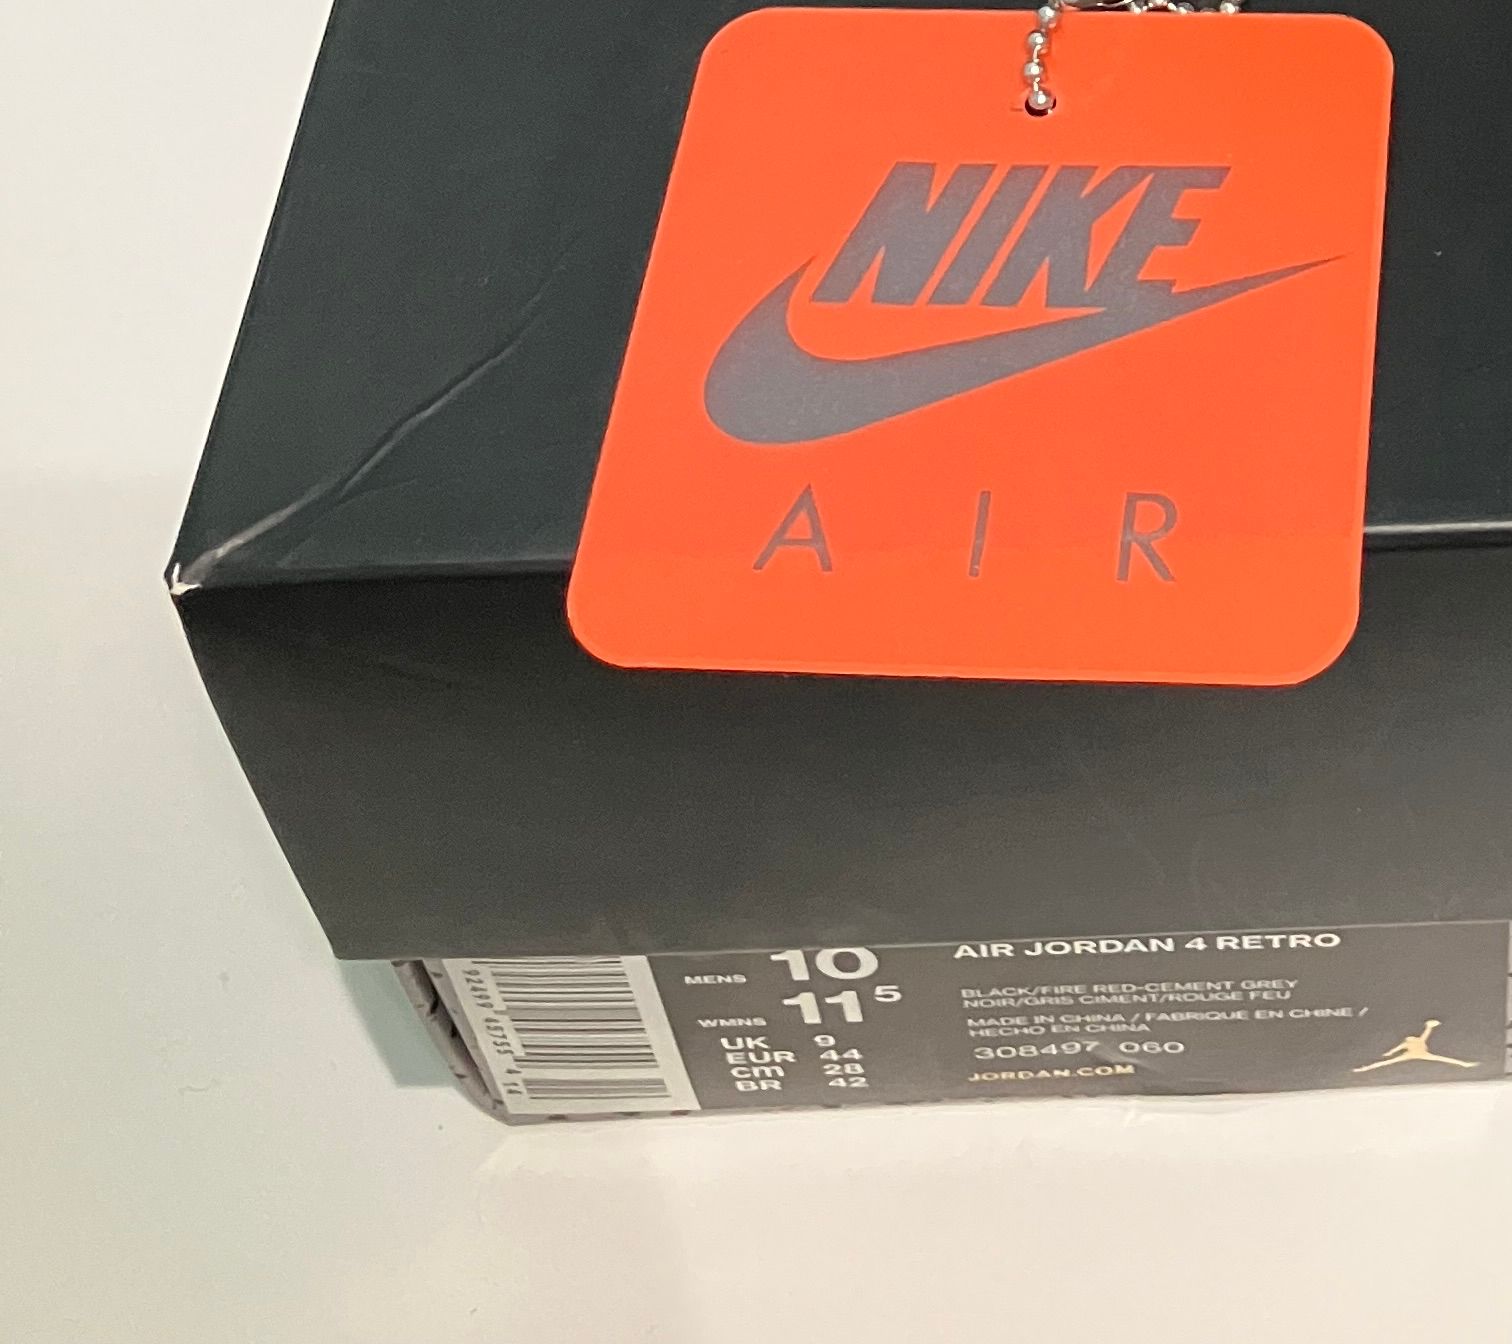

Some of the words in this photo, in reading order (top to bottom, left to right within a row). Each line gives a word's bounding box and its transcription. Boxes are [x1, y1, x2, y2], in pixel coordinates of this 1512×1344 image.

[811, 161, 1231, 309] NIKE
[753, 484, 1180, 583] AIR
[954, 943, 1015, 959] AIR
[1024, 938, 1175, 956] JORDAN
[1184, 936, 1208, 950] 4
[1216, 933, 1341, 950] RETRO
[684, 974, 747, 985] MENS
[770, 947, 878, 981] 10
[960, 983, 1087, 998] BLACK/FIRE
[1093, 980, 1234, 994] RED-CEMENT
[1240, 979, 1298, 990] GREY
[963, 995, 1074, 1008] NOIR/GRIS
[1079, 991, 1243, 1004] CIMENT/ROUGE
[1250, 990, 1291, 1000] FEU
[698, 1017, 767, 1028] WMNS
[967, 1015, 1029, 1027] MADE
[1033, 1014, 1054, 1023] IN
[1059, 1012, 1126, 1023] CHINA
[1145, 1010, 1249, 1022] FABRIQUE
[1254, 1009, 1284, 1020] EN
[1288, 1007, 1353, 1019] CHINE
[969, 1025, 1045, 1037] HECHO
[1050, 1024, 1080, 1033] EN
[1086, 1023, 1150, 1033] CHINA
[720, 1036, 771, 1050] UK
[813, 1034, 836, 1047] 9
[973, 1040, 1100, 1059] 308497
[1119, 1041, 1185, 1054] 060
[725, 1050, 797, 1065] EUR
[819, 1048, 863, 1061] 44
[730, 1065, 785, 1079] cm
[822, 1062, 865, 1075] 28
[968, 1064, 1136, 1081] JORDAN.COM
[734, 1079, 782, 1092] BR
[828, 1076, 869, 1088] 42
